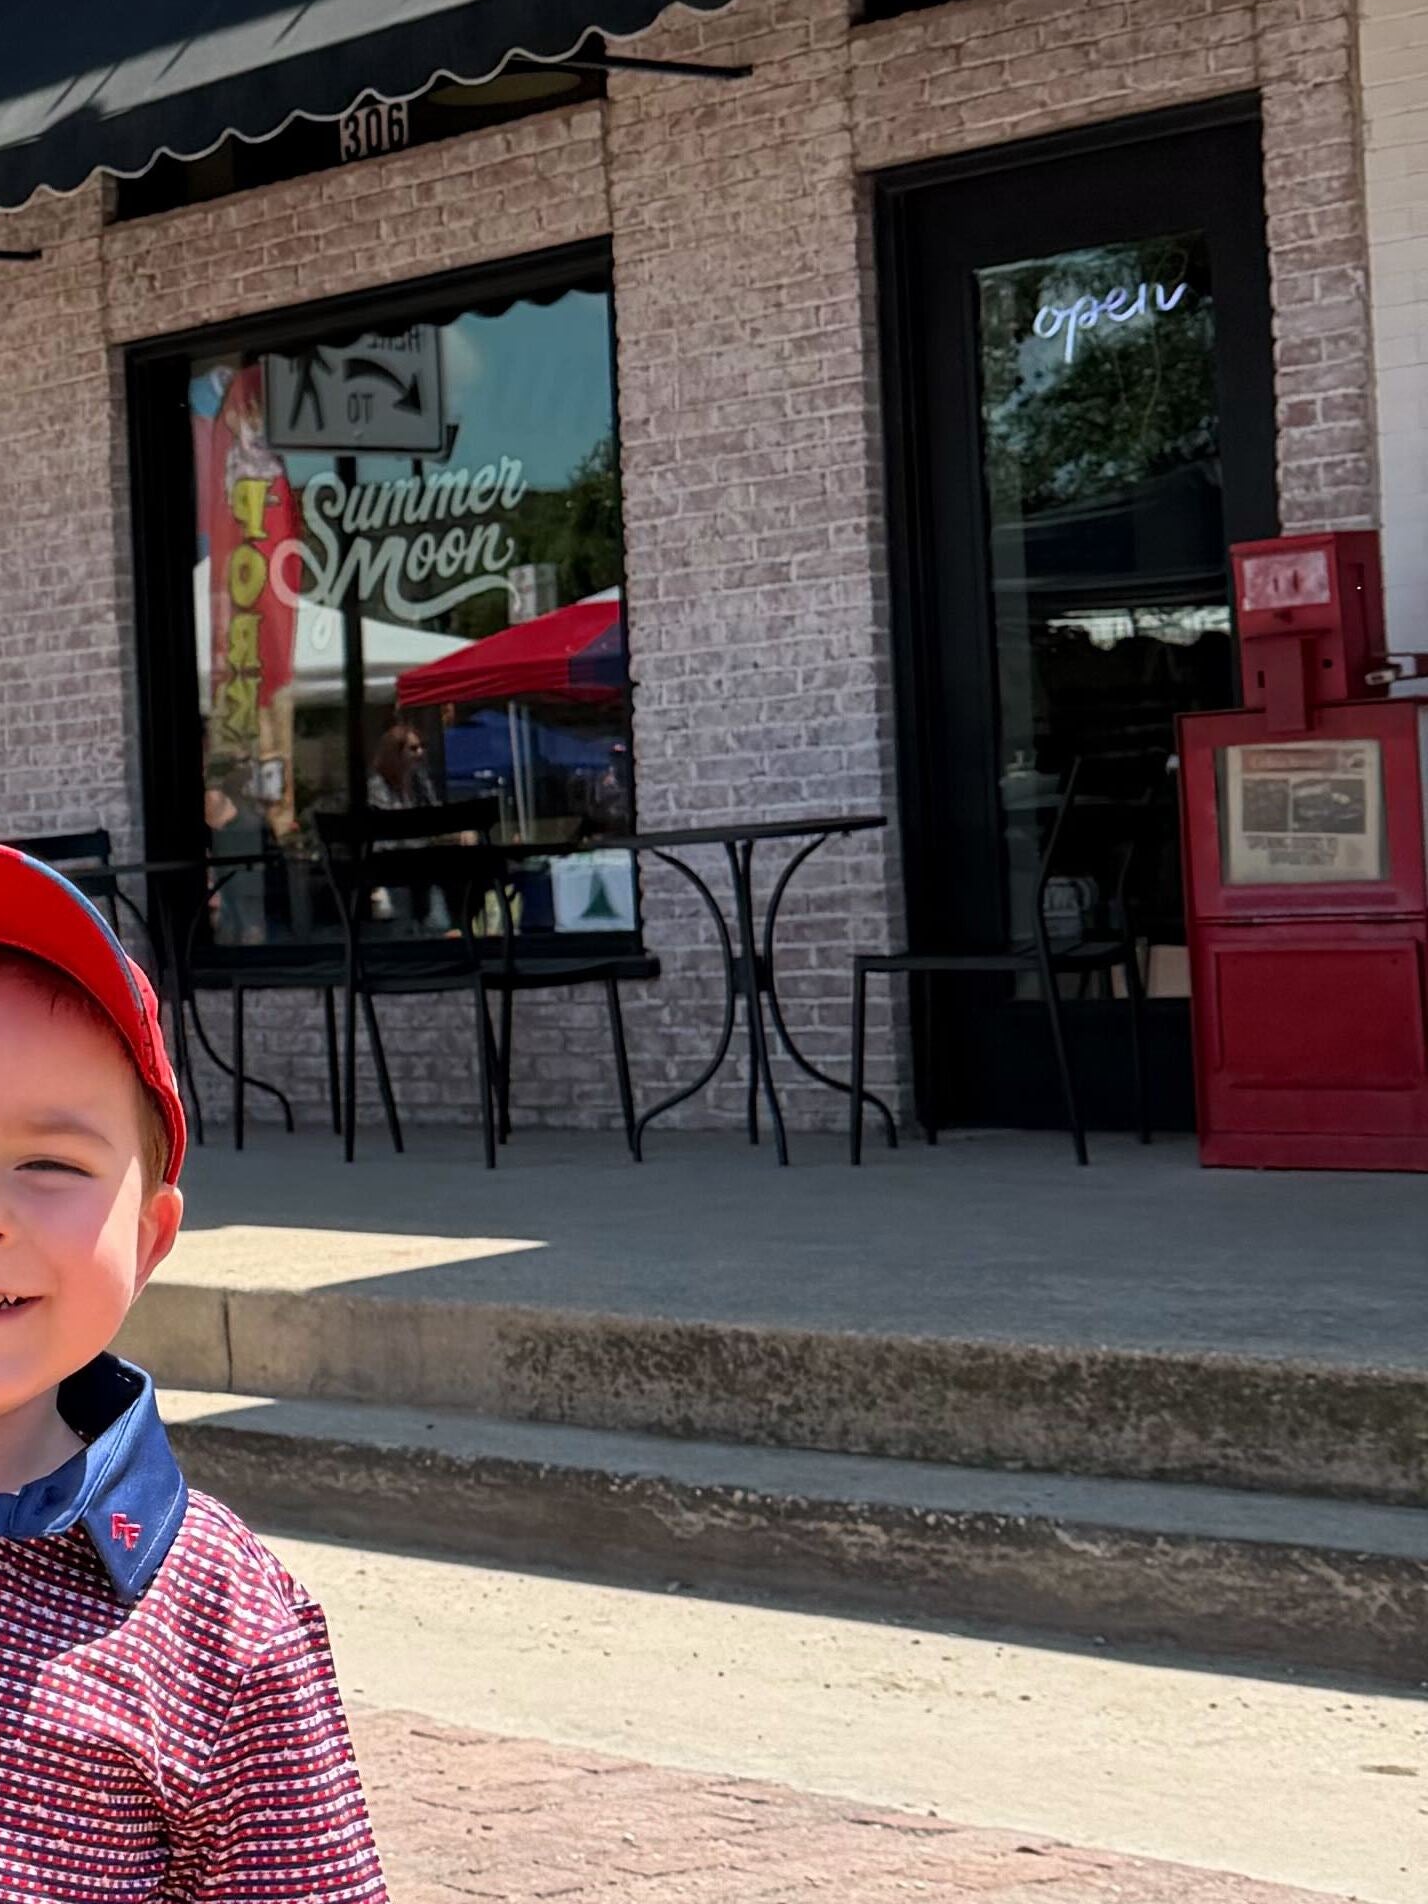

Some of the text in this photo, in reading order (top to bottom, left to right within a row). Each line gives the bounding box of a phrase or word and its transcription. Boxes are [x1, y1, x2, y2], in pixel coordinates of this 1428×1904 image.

[344, 103, 405, 159] 306
[1033, 282, 1188, 364] open
[270, 456, 528, 608] Summer
[312, 523, 522, 650] Moon
